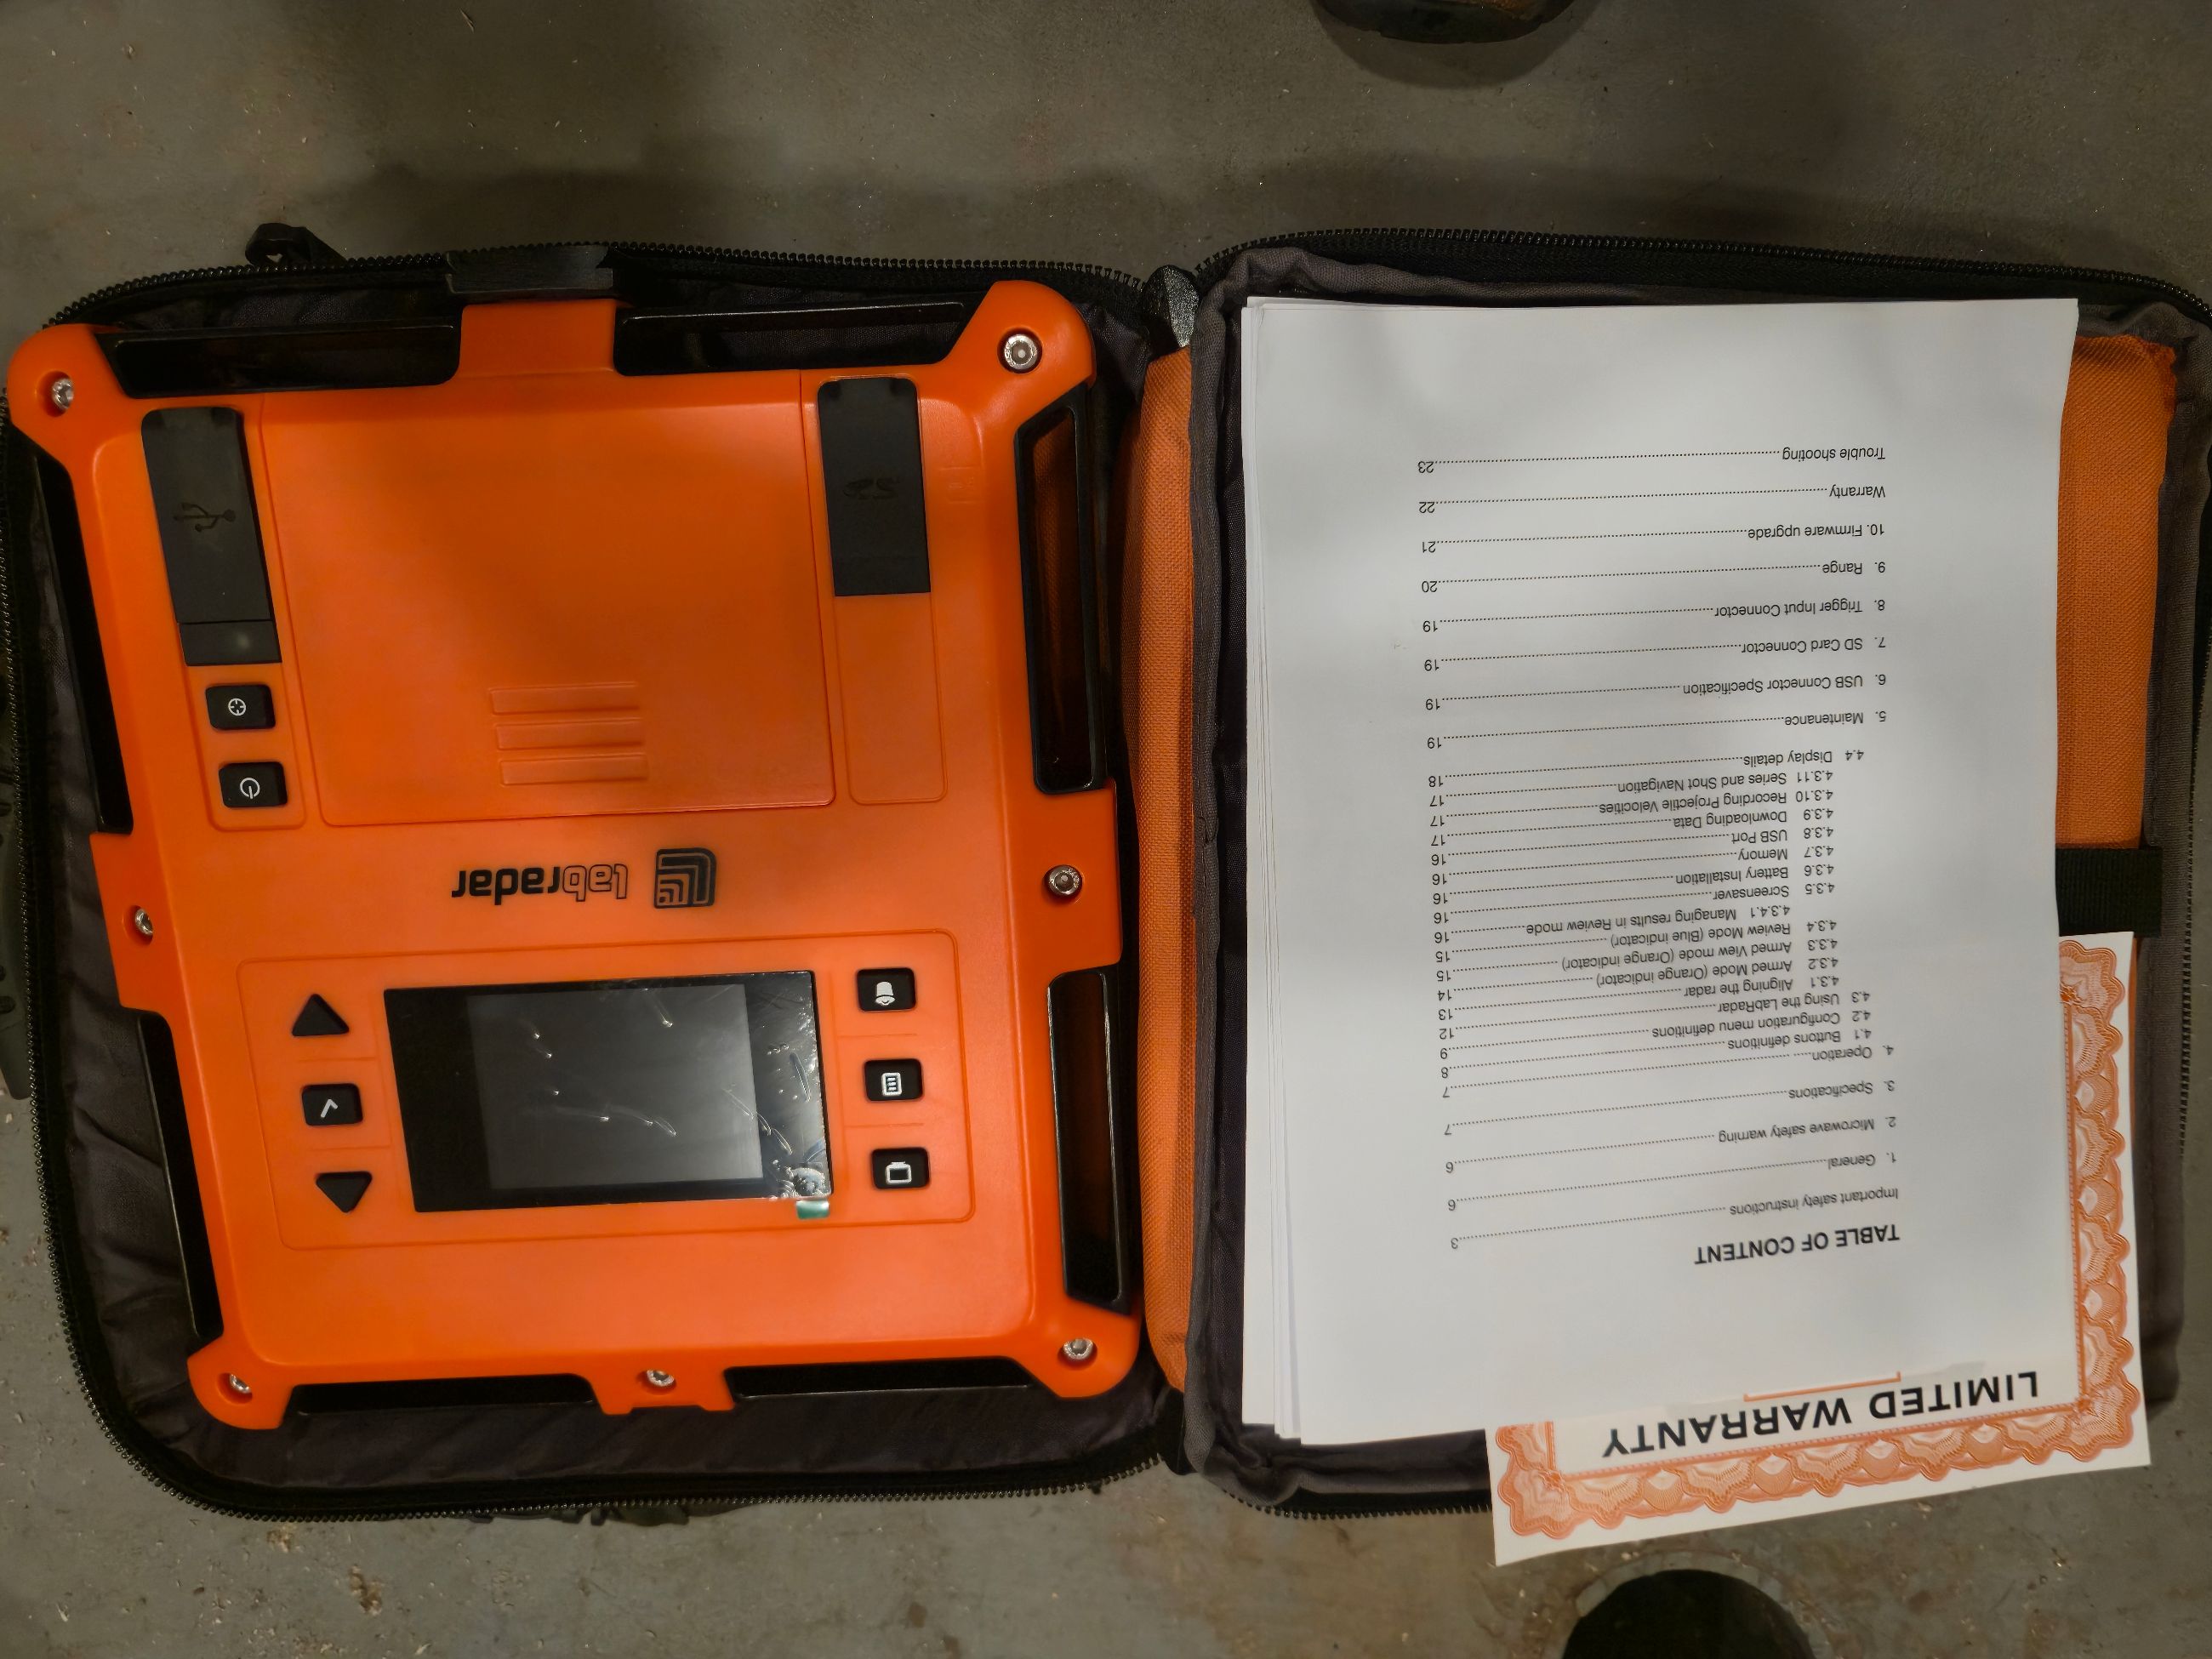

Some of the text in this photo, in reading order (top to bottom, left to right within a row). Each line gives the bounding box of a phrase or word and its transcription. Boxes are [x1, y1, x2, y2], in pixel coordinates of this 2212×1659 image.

[1417, 447, 1885, 475] Trouble shooting 23
[1419, 484, 1885, 513] Warranty 22
[1748, 524, 1800, 541] upgrade
[1804, 525, 1862, 537] Firmware
[1422, 541, 1436, 553] 21
[1822, 561, 1862, 574] Range
[1422, 579, 1437, 593] 20
[1714, 605, 1781, 619] Connector
[1784, 600, 1816, 615] Input
[1819, 598, 1863, 613] Trigger
[1422, 620, 1438, 632] 19
[1740, 641, 1806, 654] Connector
[1810, 639, 1840, 652] Card
[1844, 638, 1862, 650] SD
[1423, 659, 1440, 671] 19
[1682, 678, 1763, 698] Specification
[1767, 677, 1831, 691] Connector
[1834, 676, 1863, 687] USB
[1423, 698, 1440, 710] 19
[1783, 712, 1863, 725] Maintenance
[1428, 737, 1441, 749] 19
[1428, 750, 1864, 787] 4.4 Display details 18
[1429, 771, 1833, 807] 4.3.11 Series and Shot Navigation 17
[1430, 790, 1833, 828] 4.3.10 Recording Projectile Velocities 17
[1431, 808, 1833, 846] 4.3.9 Downloading Data 17
[1431, 827, 1833, 865] 4.3.8 USB Port 16
[1432, 846, 1833, 885] 4.3.7 Memory 16
[452, 864, 629, 905] labradar
[1433, 864, 1834, 904] 4.3.6 Battery Installation 16
[1434, 882, 1835, 924] 4.3.5 Screensaver 16
[1434, 905, 1790, 944] 4.3.4.1 Managing results in Review mode 16
[1435, 920, 1837, 962] 4.3.4 Review Mode (Blue indicator) 15
[1436, 938, 1838, 982] 4.3.3 Armed View mode (Orange indicator) 15
[1437, 957, 1839, 1001] 4.3.2 Armed Mode (Orange indicator) 14
[1439, 976, 1839, 1020] 4.3.1 Aligning the radar 13
[1440, 991, 1870, 1040] 4.3 Using the LabRadar 12
[1440, 1010, 1871, 1059] 4.2 Configuration menu definitions 9
[1441, 1029, 1872, 1079] 4.1 Buttons definitions 8
[1810, 1045, 1872, 1062] Operation
[1442, 1086, 1450, 1098] 7
[1788, 1080, 1873, 1099] Specifications
[1445, 1124, 1451, 1136] 7
[1770, 1125, 1806, 1138] safety
[1810, 1119, 1874, 1133] Microwave
[1719, 1130, 1767, 1143] warning
[1446, 1162, 1453, 1173] 6
[1826, 1154, 1876, 1170] General
[1448, 1200, 1456, 1211] 6
[1451, 1187, 1898, 1249] Important safety instructions 3
[1694, 1224, 1899, 1265] TABLE OF CONTENT
[1602, 1371, 2038, 1457] LIMITED WARRANTY
